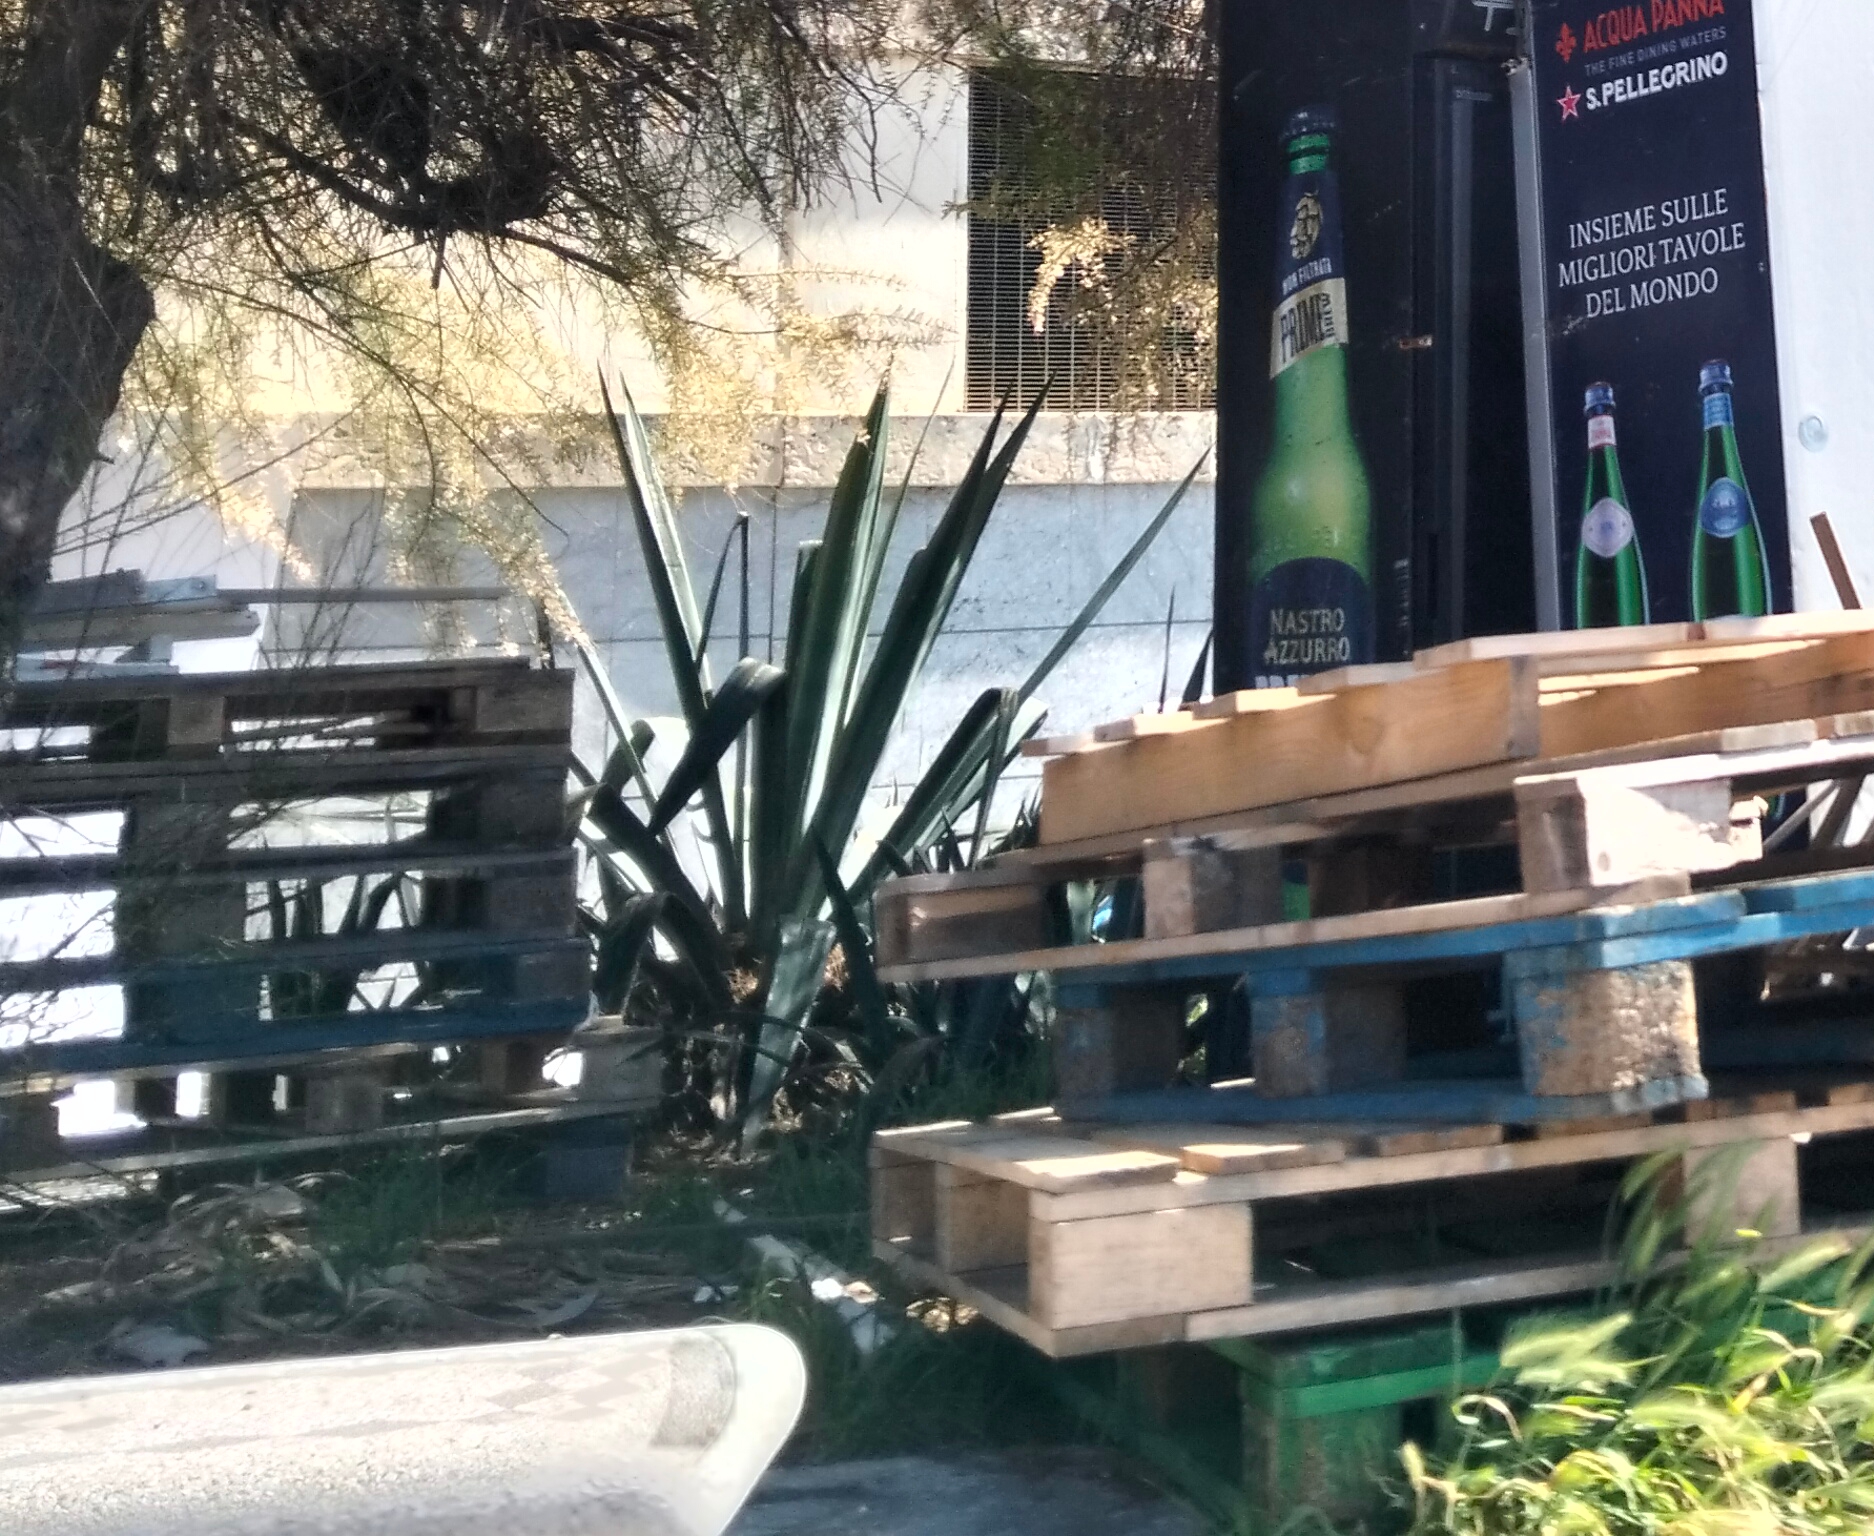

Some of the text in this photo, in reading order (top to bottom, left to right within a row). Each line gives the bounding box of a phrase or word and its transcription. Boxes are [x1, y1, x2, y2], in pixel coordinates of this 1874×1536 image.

[1583, 5, 1648, 53] ACQUA
[1609, 53, 1636, 70] FINE
[1636, 40, 1677, 62] DINING
[1680, 26, 1727, 51] WATERS
[1586, 51, 1729, 111] S.PELLEGRINO
[1569, 188, 1729, 248] INSIEME SULLE
[1558, 223, 1746, 288] MIGLIORI TAVOLE
[1586, 267, 1719, 318] DEL MONDO
[1270, 608, 1345, 636] NASTRO
[1264, 636, 1350, 665] AZZURRO
